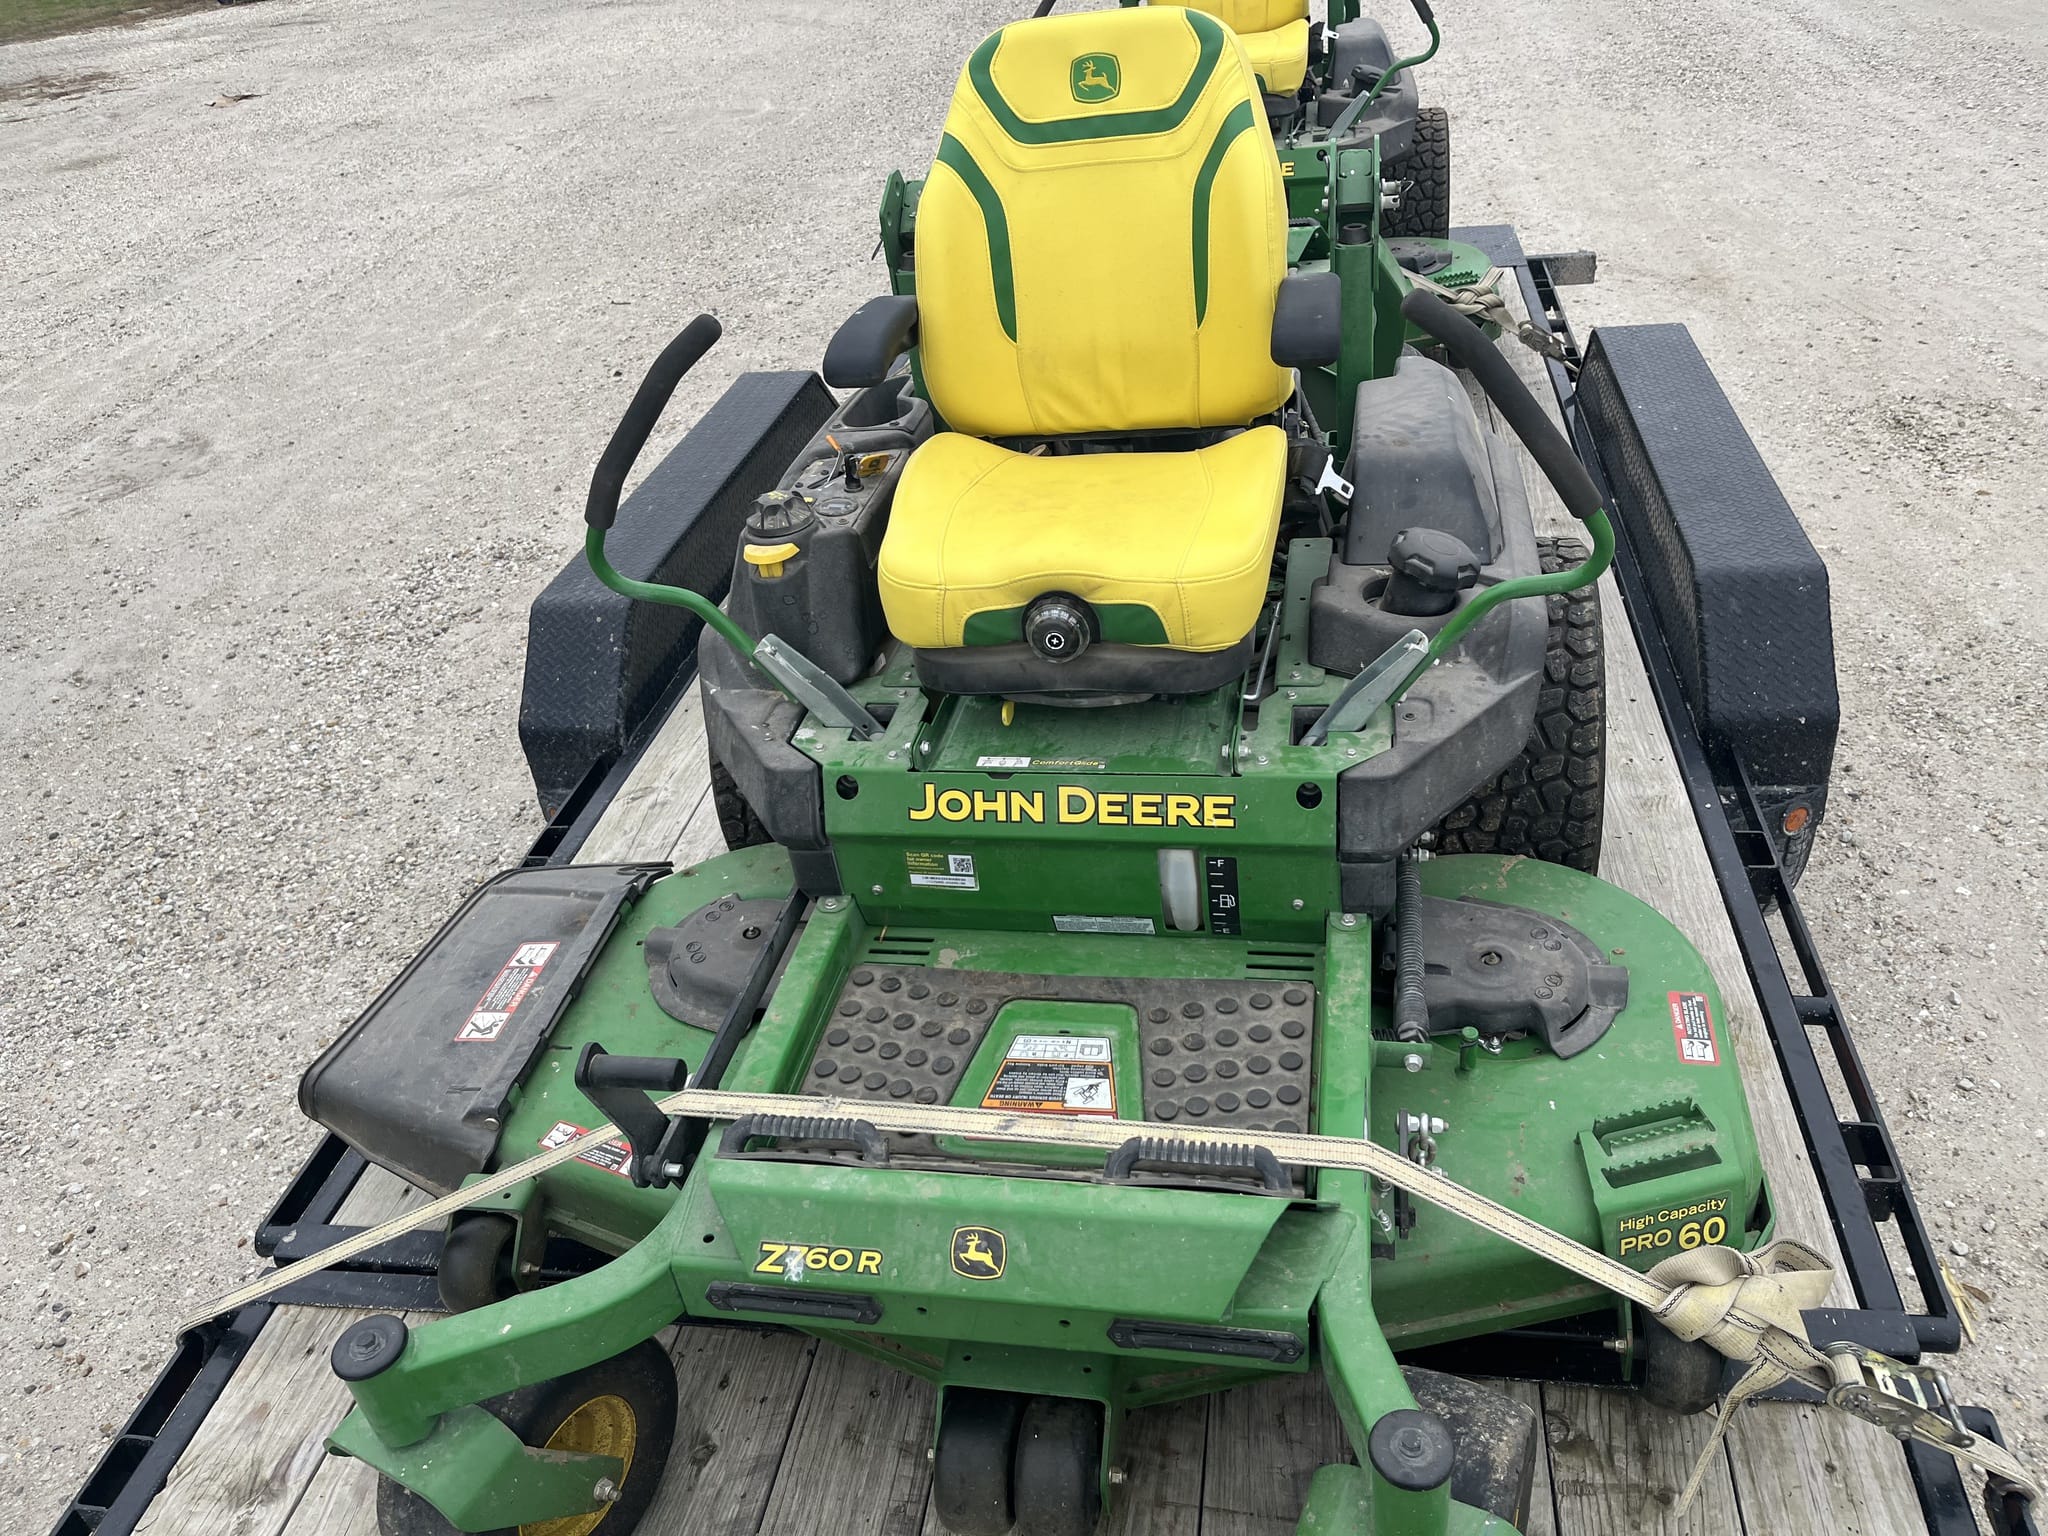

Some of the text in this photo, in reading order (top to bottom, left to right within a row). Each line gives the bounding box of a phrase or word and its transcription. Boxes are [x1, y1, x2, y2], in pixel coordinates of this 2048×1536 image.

[908, 782, 1236, 828] JOHN DEERE
[1217, 859, 1225, 867] F
[511, 977, 536, 1006] DANGER
[1671, 1003, 1682, 1024] DANGER
[999, 1100, 1035, 1108] WARNING
[1620, 1198, 1727, 1232] High Capacity
[1620, 1216, 1726, 1256] PRO 60
